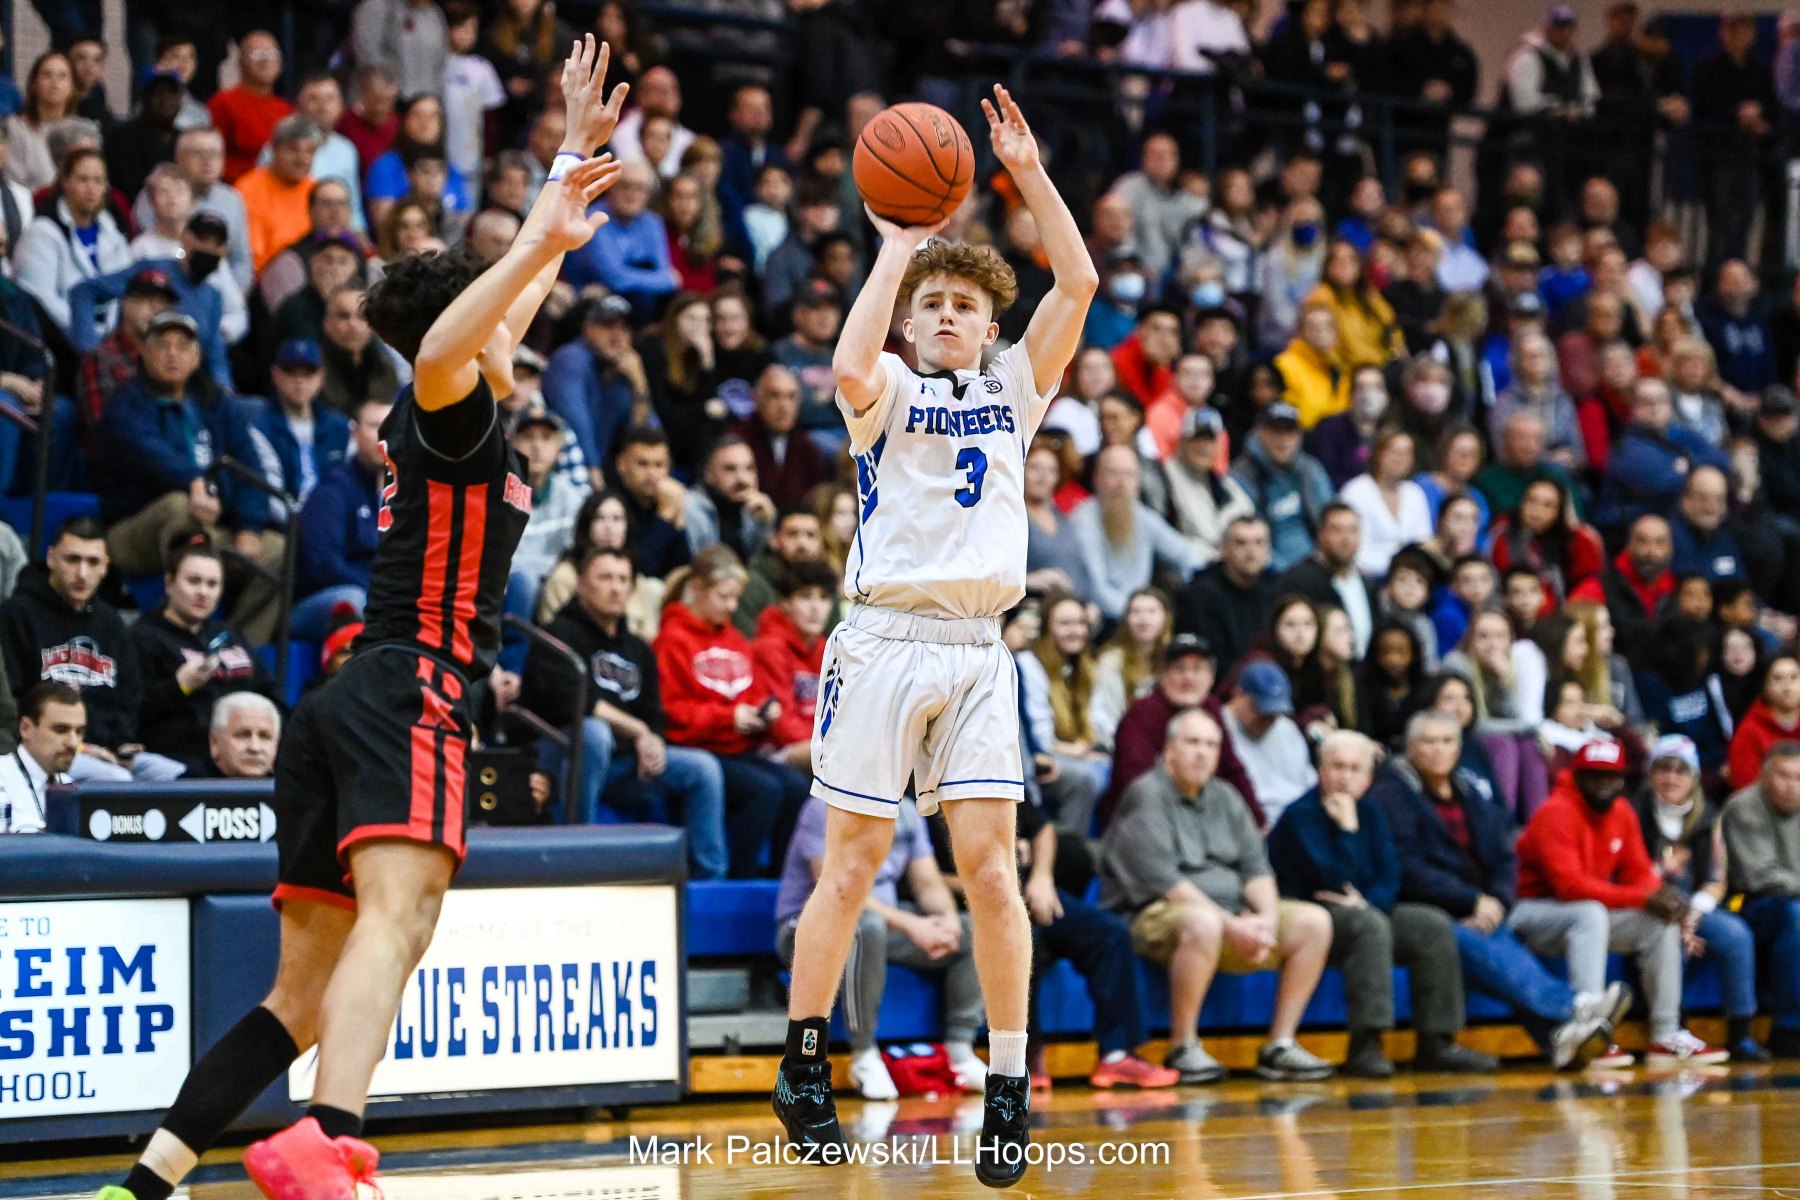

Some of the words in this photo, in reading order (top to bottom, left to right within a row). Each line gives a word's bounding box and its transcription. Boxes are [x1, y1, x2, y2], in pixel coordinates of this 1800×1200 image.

[954, 446, 989, 508] 3
[112, 814, 144, 835] BONUS
[205, 807, 260, 840] POSS
[19, 916, 51, 937] TO
[0, 944, 156, 998] EIM
[394, 967, 467, 1060] LUE
[482, 960, 657, 1055] STREAKS
[0, 1004, 174, 1060] SHIP
[0, 1071, 96, 1103] HOOL
